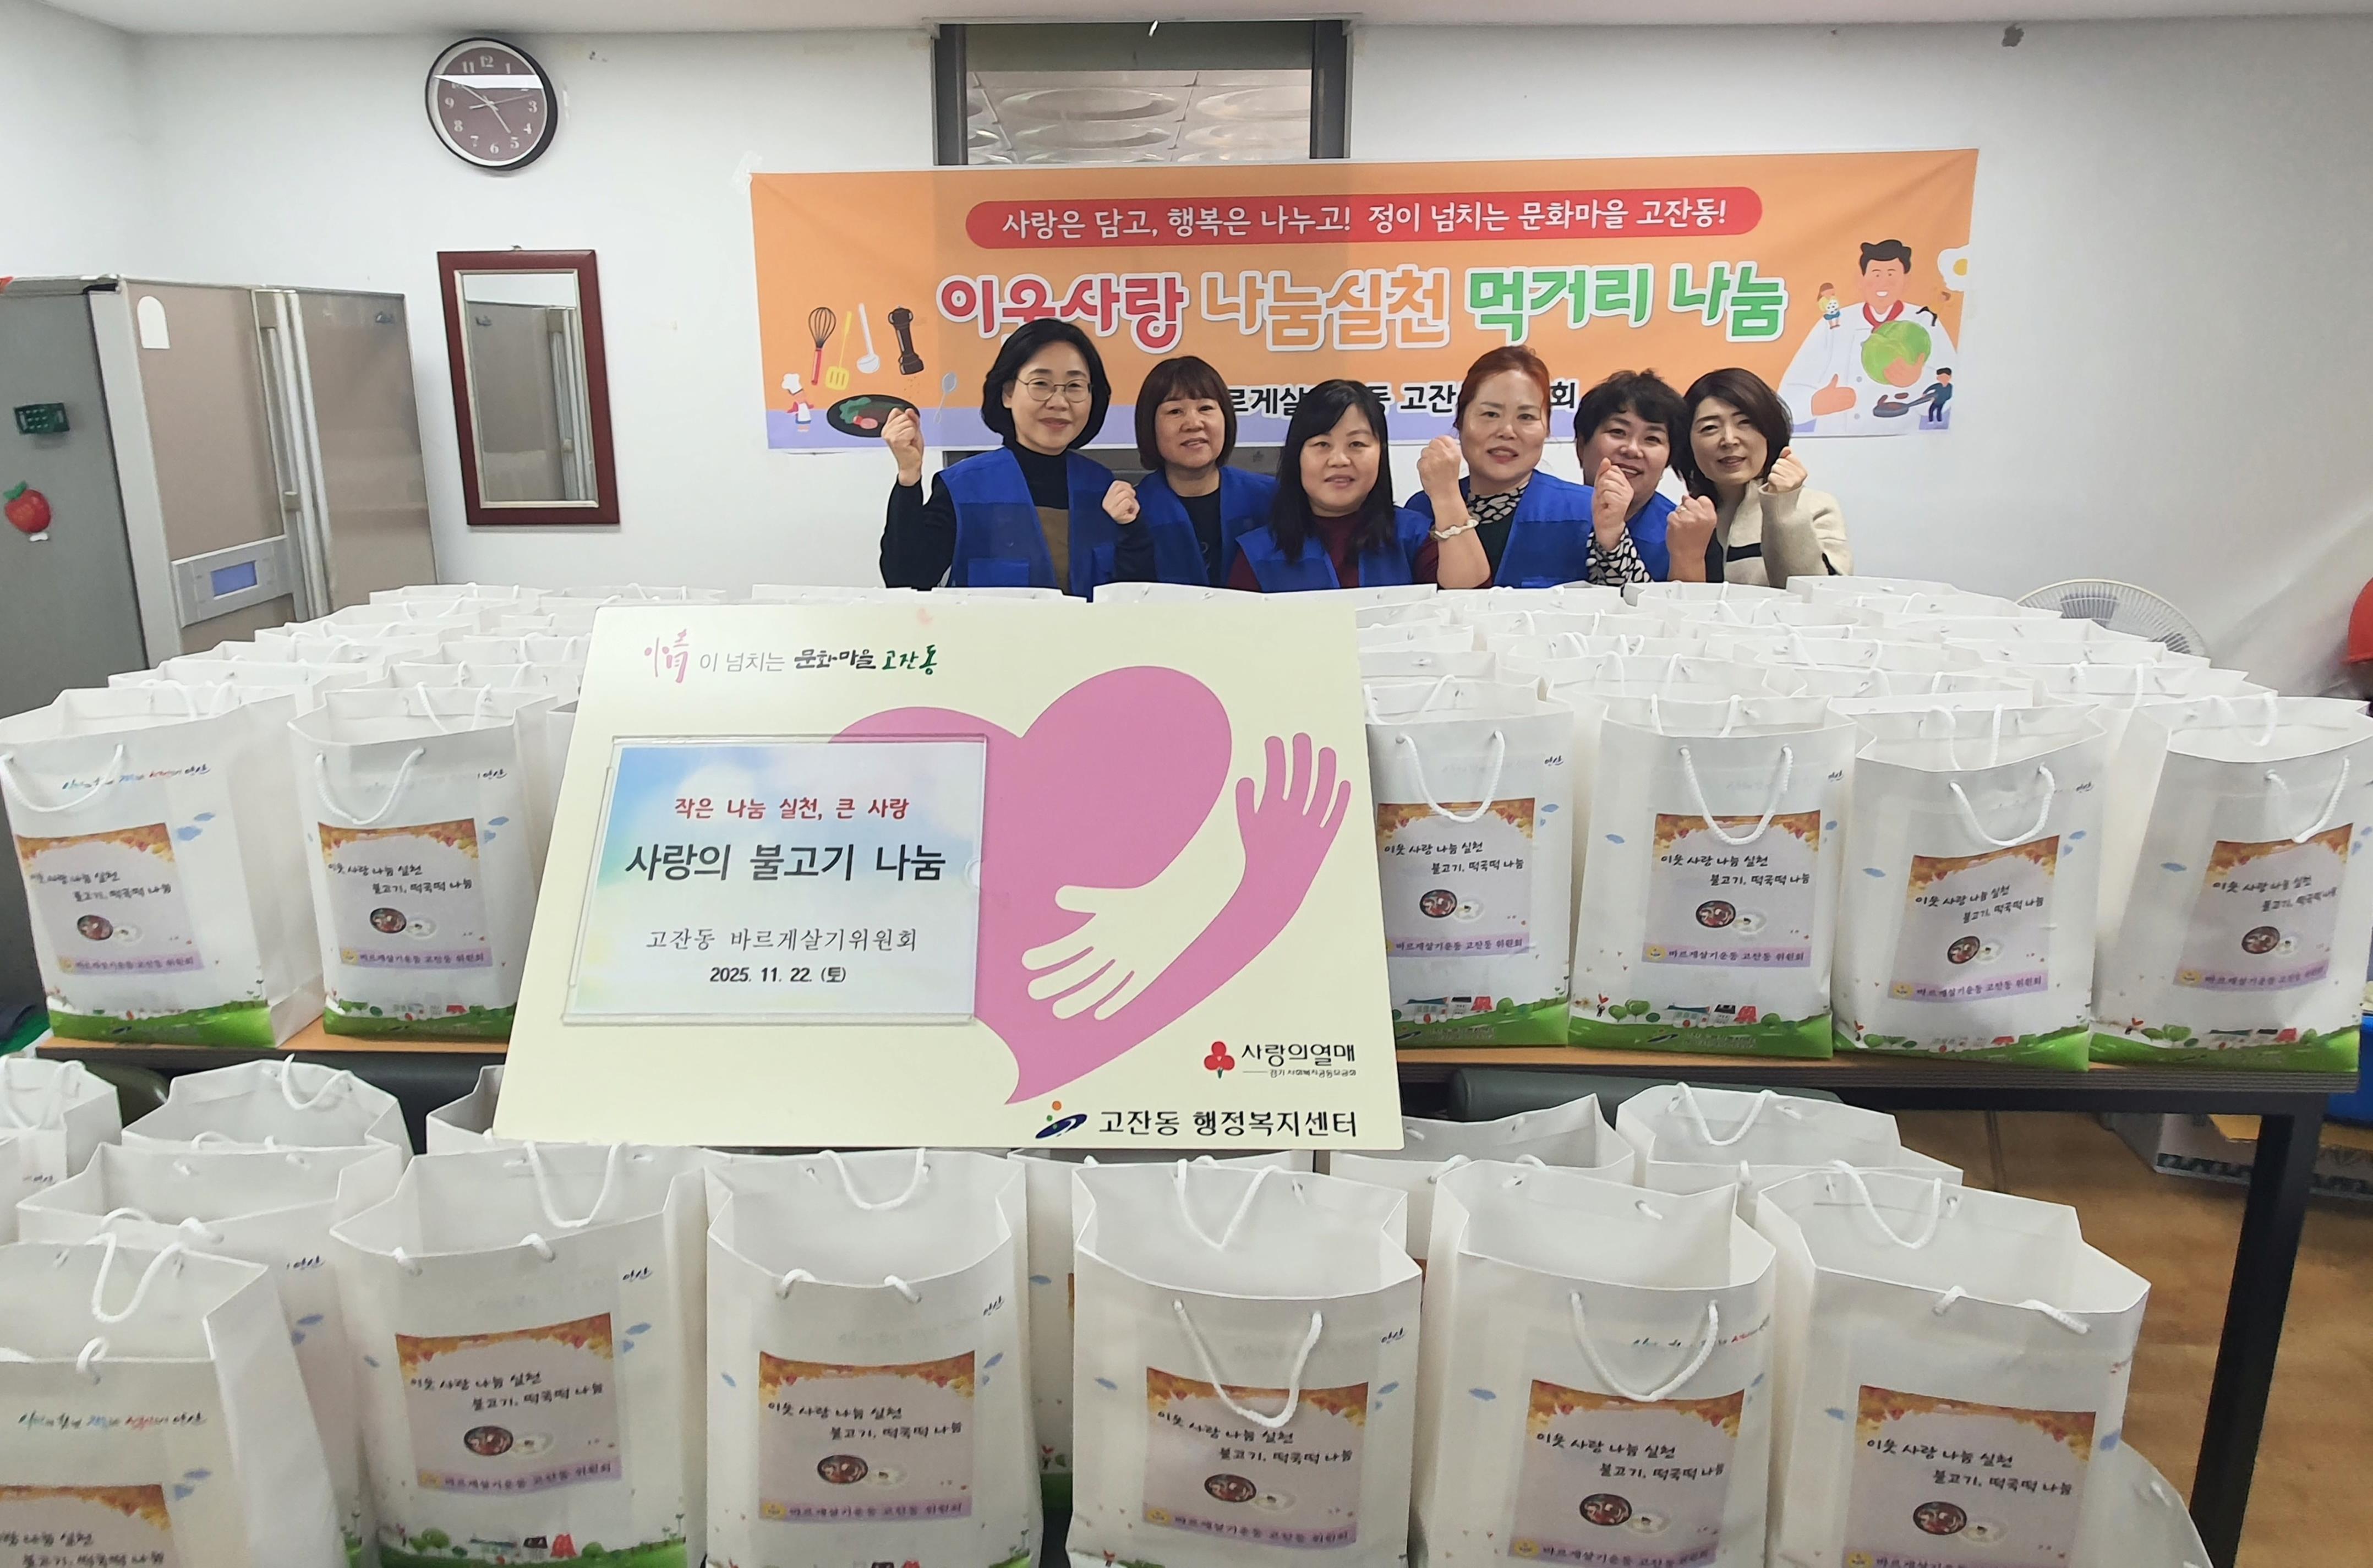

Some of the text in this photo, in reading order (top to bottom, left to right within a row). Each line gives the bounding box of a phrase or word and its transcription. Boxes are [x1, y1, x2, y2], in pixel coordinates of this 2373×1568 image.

[463, 62, 474, 73] 11
[480, 56, 494, 67] 12
[445, 97, 454, 108] 9
[528, 101, 537, 113] 3
[454, 120, 463, 132] 8
[471, 135, 478, 147] 7
[490, 143, 499, 154] 6
[510, 137, 520, 149] 5
[1003, 198, 1726, 240] 사랑은 담고, 행복은 나누고! 정이 넘치는 문화마을 고잔동!
[1202, 265, 1448, 351] 나눔실천
[1465, 264, 1654, 346] 먹거리
[1668, 261, 1789, 343] 나눔
[1401, 384, 1456, 413] 고잔
[726, 652, 785, 673] 넘치는
[795, 648, 876, 669] 문화마을
[882, 644, 937, 675] 고잔동
[675, 797, 910, 821] 작은 나눔 실천, 큰 사랑
[1384, 841, 1483, 856] 이웃 사랑 나눔 실천
[625, 844, 945, 882] 사랑의 불고기 나눔
[1468, 860, 1500, 872] 떡국떡
[1503, 858, 1524, 869] 나눔
[1660, 854, 1769, 868] 이웃 사랑 나눔 실천
[1751, 875, 1787, 886] 떡국떡
[1790, 873, 1809, 884] 나눔
[1915, 885, 2010, 908] 이웃 사랑 나눔 실천
[646, 928, 917, 952] 고잔동 바르게살기위원회
[710, 966, 847, 984] 2025. 11. 22. (토)
[1241, 1043, 1355, 1067] 사랑의열매
[1099, 1110, 1358, 1138] 고잔동 행정복지센터
[1537, 1432, 1676, 1460] 이웃 사랑 나눔 실천
[1867, 1438, 2014, 1469] 이웃 사랑 나눔 실천
[1653, 1467, 1697, 1480] 떡국떡
[1701, 1463, 1725, 1477] 나눔
[1989, 1477, 2038, 1493] 떡국떡
[2042, 1482, 2073, 1496] 나눔
